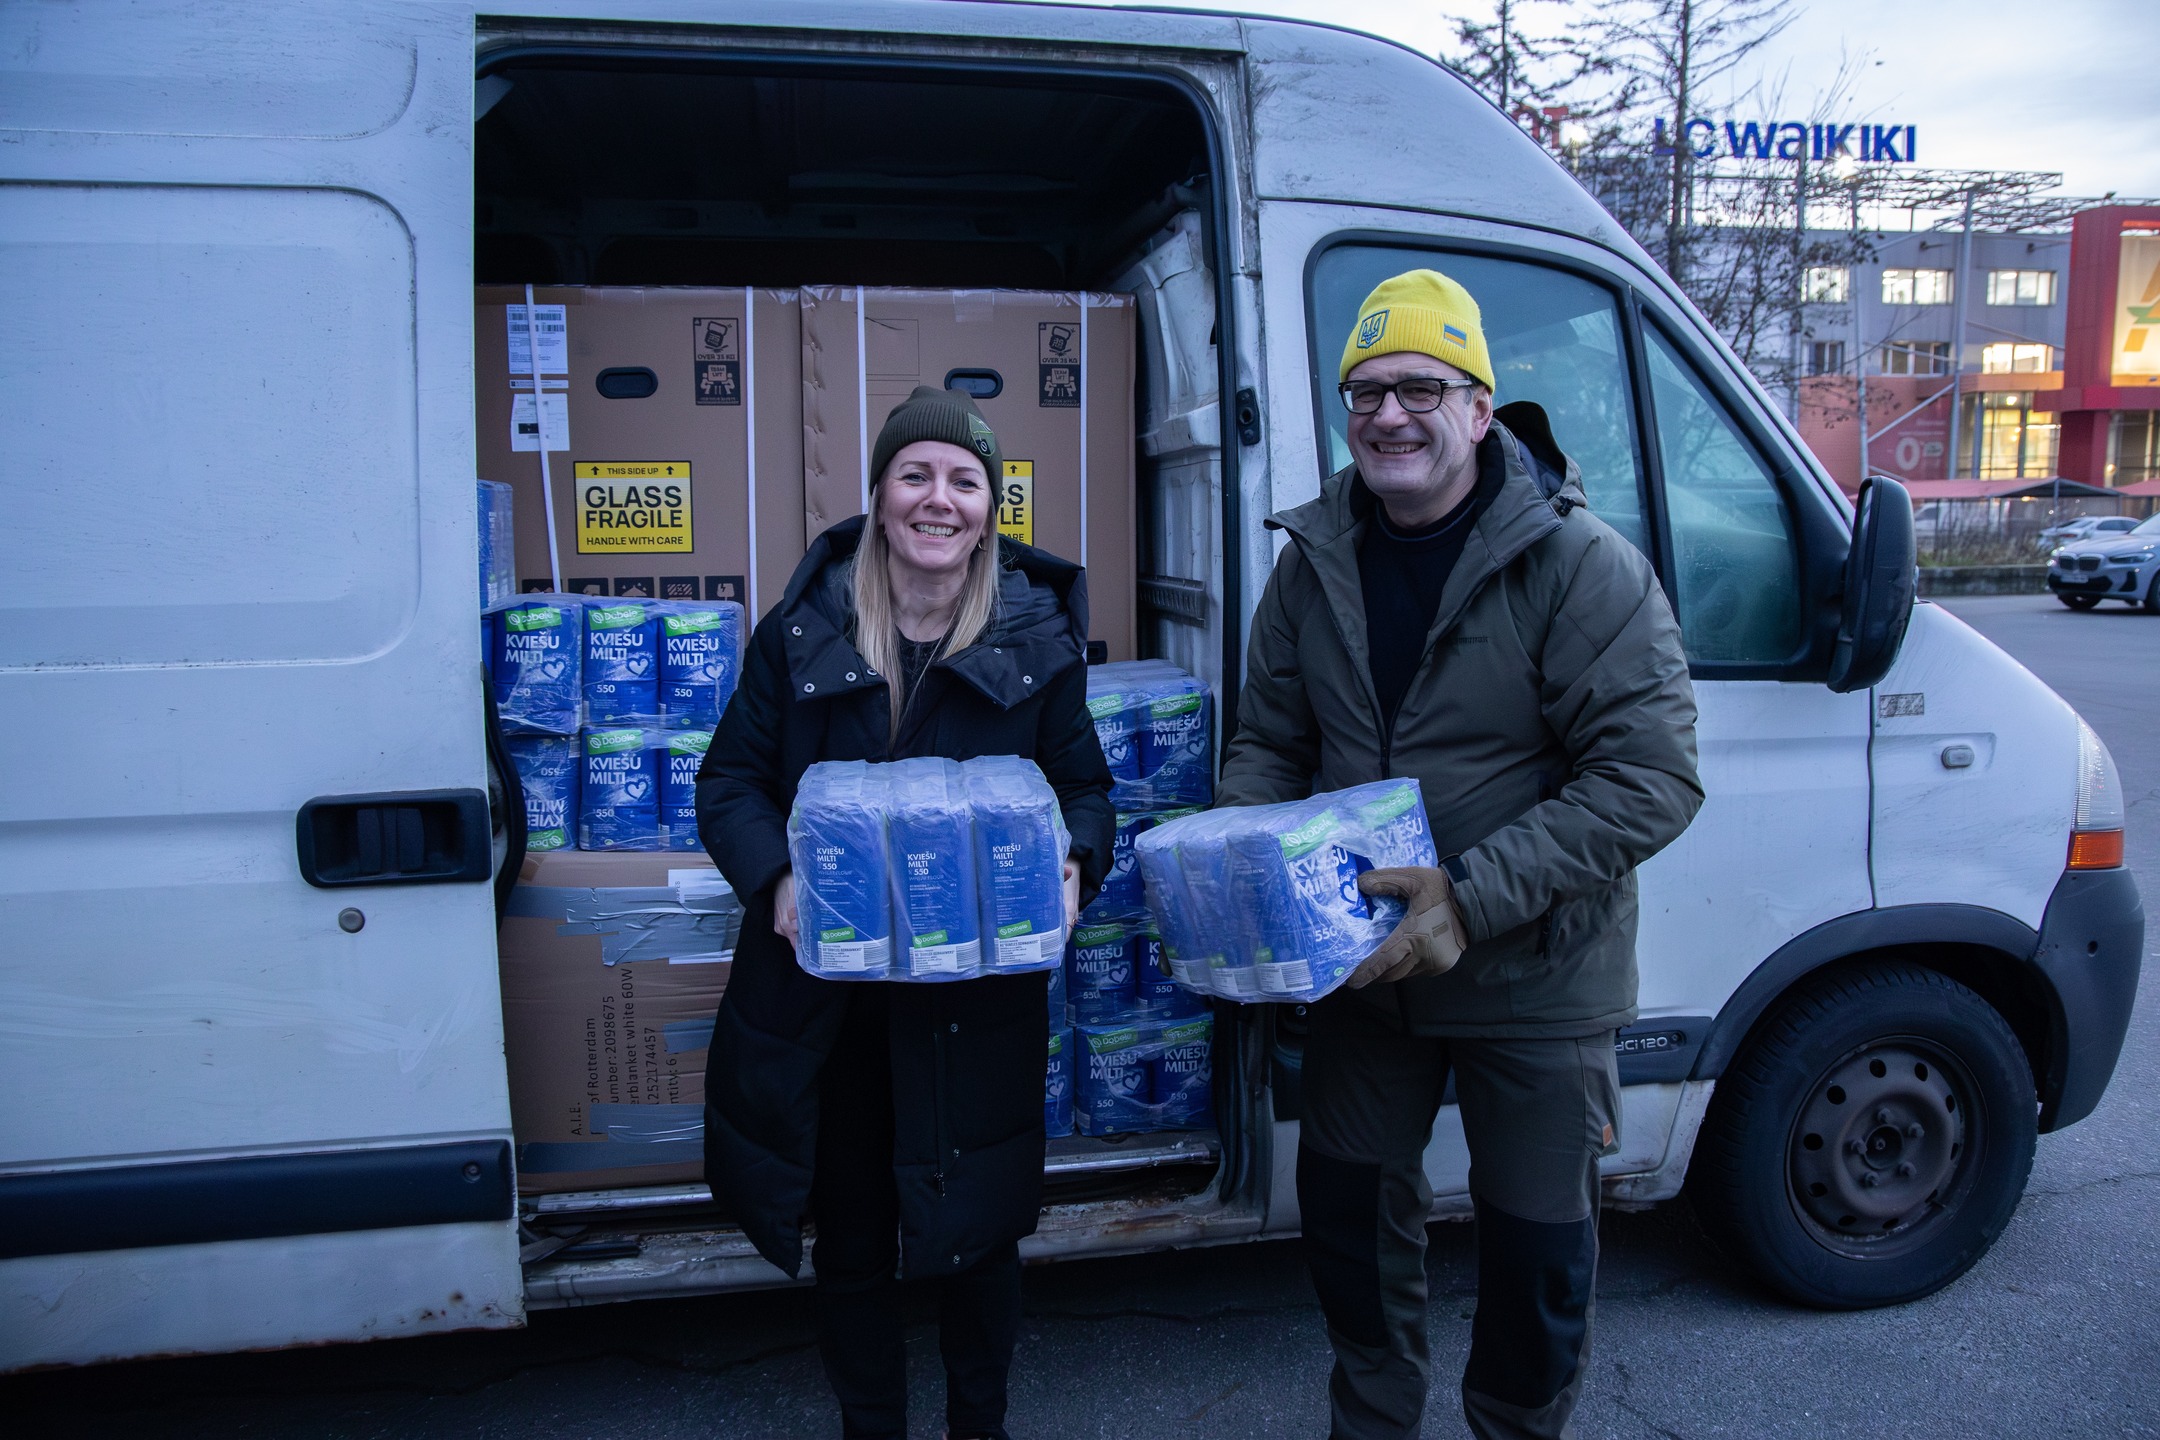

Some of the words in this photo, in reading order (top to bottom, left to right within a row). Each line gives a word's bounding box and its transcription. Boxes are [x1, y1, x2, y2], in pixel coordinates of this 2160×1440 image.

[1654, 117, 1716, 158] LC
[607, 467, 626, 475] THIS
[627, 467, 646, 475] SIDE
[647, 467, 659, 475] UP
[585, 485, 682, 509] GLASS
[586, 509, 683, 528] FRAGILE
[586, 537, 627, 545] HANDLE
[628, 536, 655, 545] WITH
[656, 536, 684, 545] CARE
[604, 609, 638, 621] Dobele
[506, 630, 560, 649] KVIEŠU
[590, 628, 644, 647] KVIEŠU
[667, 633, 719, 652] KVIEŠU
[505, 649, 544, 664] MILTI
[590, 646, 628, 661] MILTI
[667, 653, 705, 666] MILTI
[596, 684, 616, 694] 550
[674, 688, 693, 698] 550
[602, 733, 636, 746] Dobele
[589, 753, 642, 771] KVIEŠU
[1160, 767, 1178, 776] 550
[589, 771, 626, 785] MILTI
[595, 808, 615, 818] 550
[677, 808, 697, 818] 550
[816, 846, 845, 855] KVIEŠU
[992, 843, 1021, 853] KVIEŠU
[817, 854, 837, 862] MILTI
[907, 851, 936, 861] KVIEŠU
[993, 852, 1013, 860] MILTI
[822, 862, 838, 871] 550
[907, 860, 928, 868] MILTI
[999, 859, 1014, 868] 550
[914, 868, 929, 876] 550
[829, 930, 851, 938] Dobele
[1006, 924, 1028, 934] Dobele
[1315, 926, 1338, 942] 550
[922, 933, 943, 943] Dobele
[1075, 943, 1123, 961] KVIEŠU
[1075, 960, 1110, 973] MILTI
[621, 968, 634, 998] 60W
[1155, 985, 1173, 994] 550
[622, 1001, 636, 1040] white
[1614, 1039, 1638, 1052] dCi
[1640, 1036, 1668, 1049] 120
[584, 1017, 599, 1088] Rotterdam
[1090, 1053, 1138, 1067] KVIEŠU
[1165, 1060, 1198, 1073] MILTI
[1096, 1099, 1114, 1108] 550
[570, 1101, 582, 1136] A.I.E.
